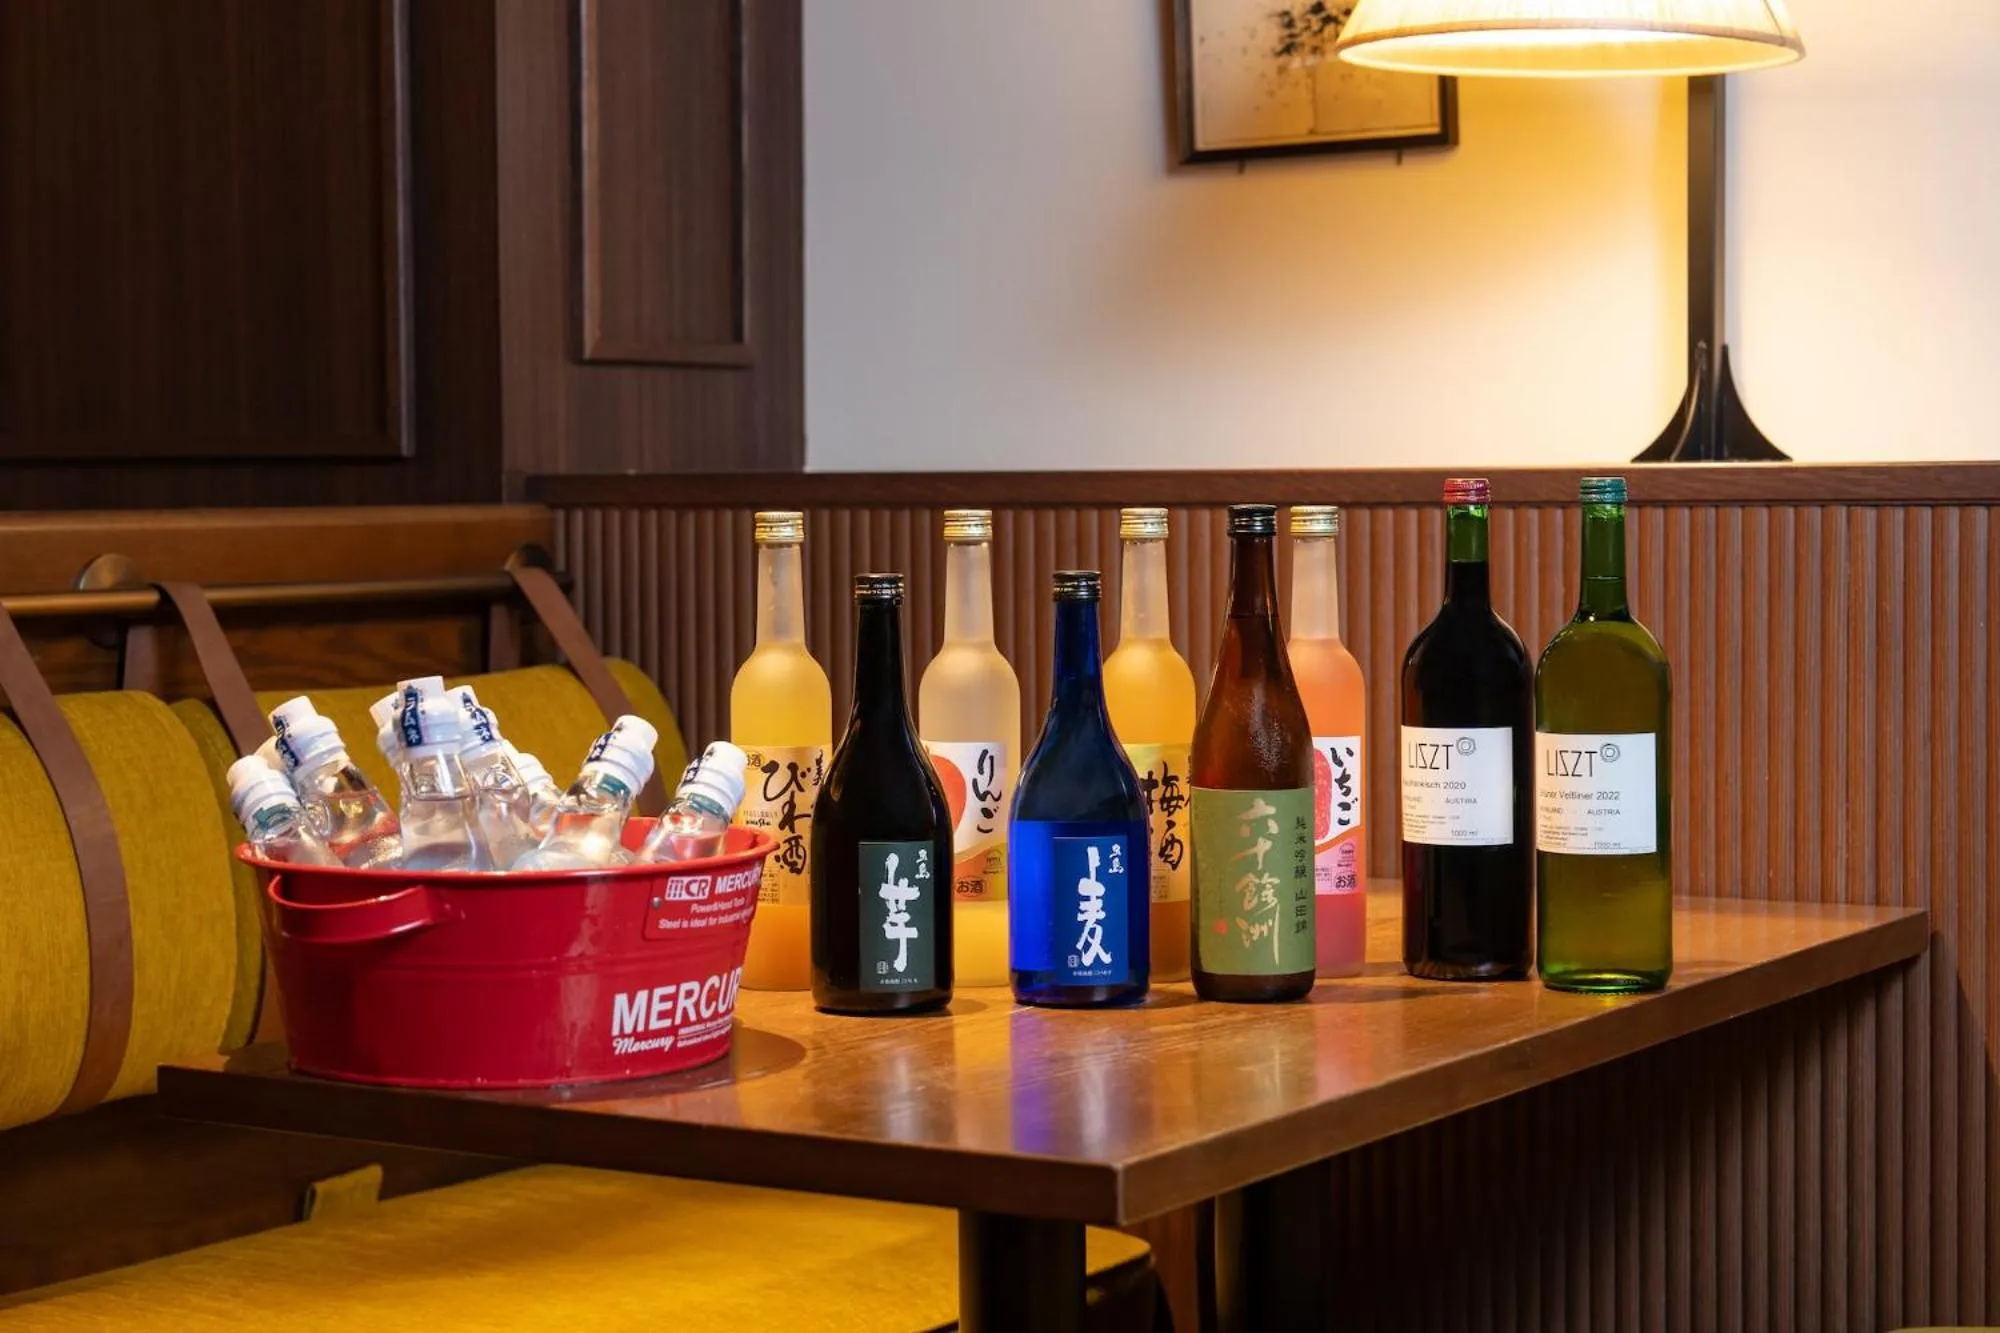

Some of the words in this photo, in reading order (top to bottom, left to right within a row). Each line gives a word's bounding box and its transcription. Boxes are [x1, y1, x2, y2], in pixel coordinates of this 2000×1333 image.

[403, 696, 421, 743] ラムネ
[1408, 743, 1454, 770] LISZT
[1546, 749, 1598, 777] LISZT
[972, 749, 1002, 833] りんご
[1330, 747, 1358, 826] いちご
[1443, 781, 1467, 790] 2020
[1596, 791, 1621, 801] 2022
[760, 760, 812, 875] びわ酒
[1587, 808, 1621, 816] AUSTRIA
[956, 880, 984, 894] お酒
[611, 966, 742, 1037] MERCUR
[612, 1035, 675, 1056] Mercury
